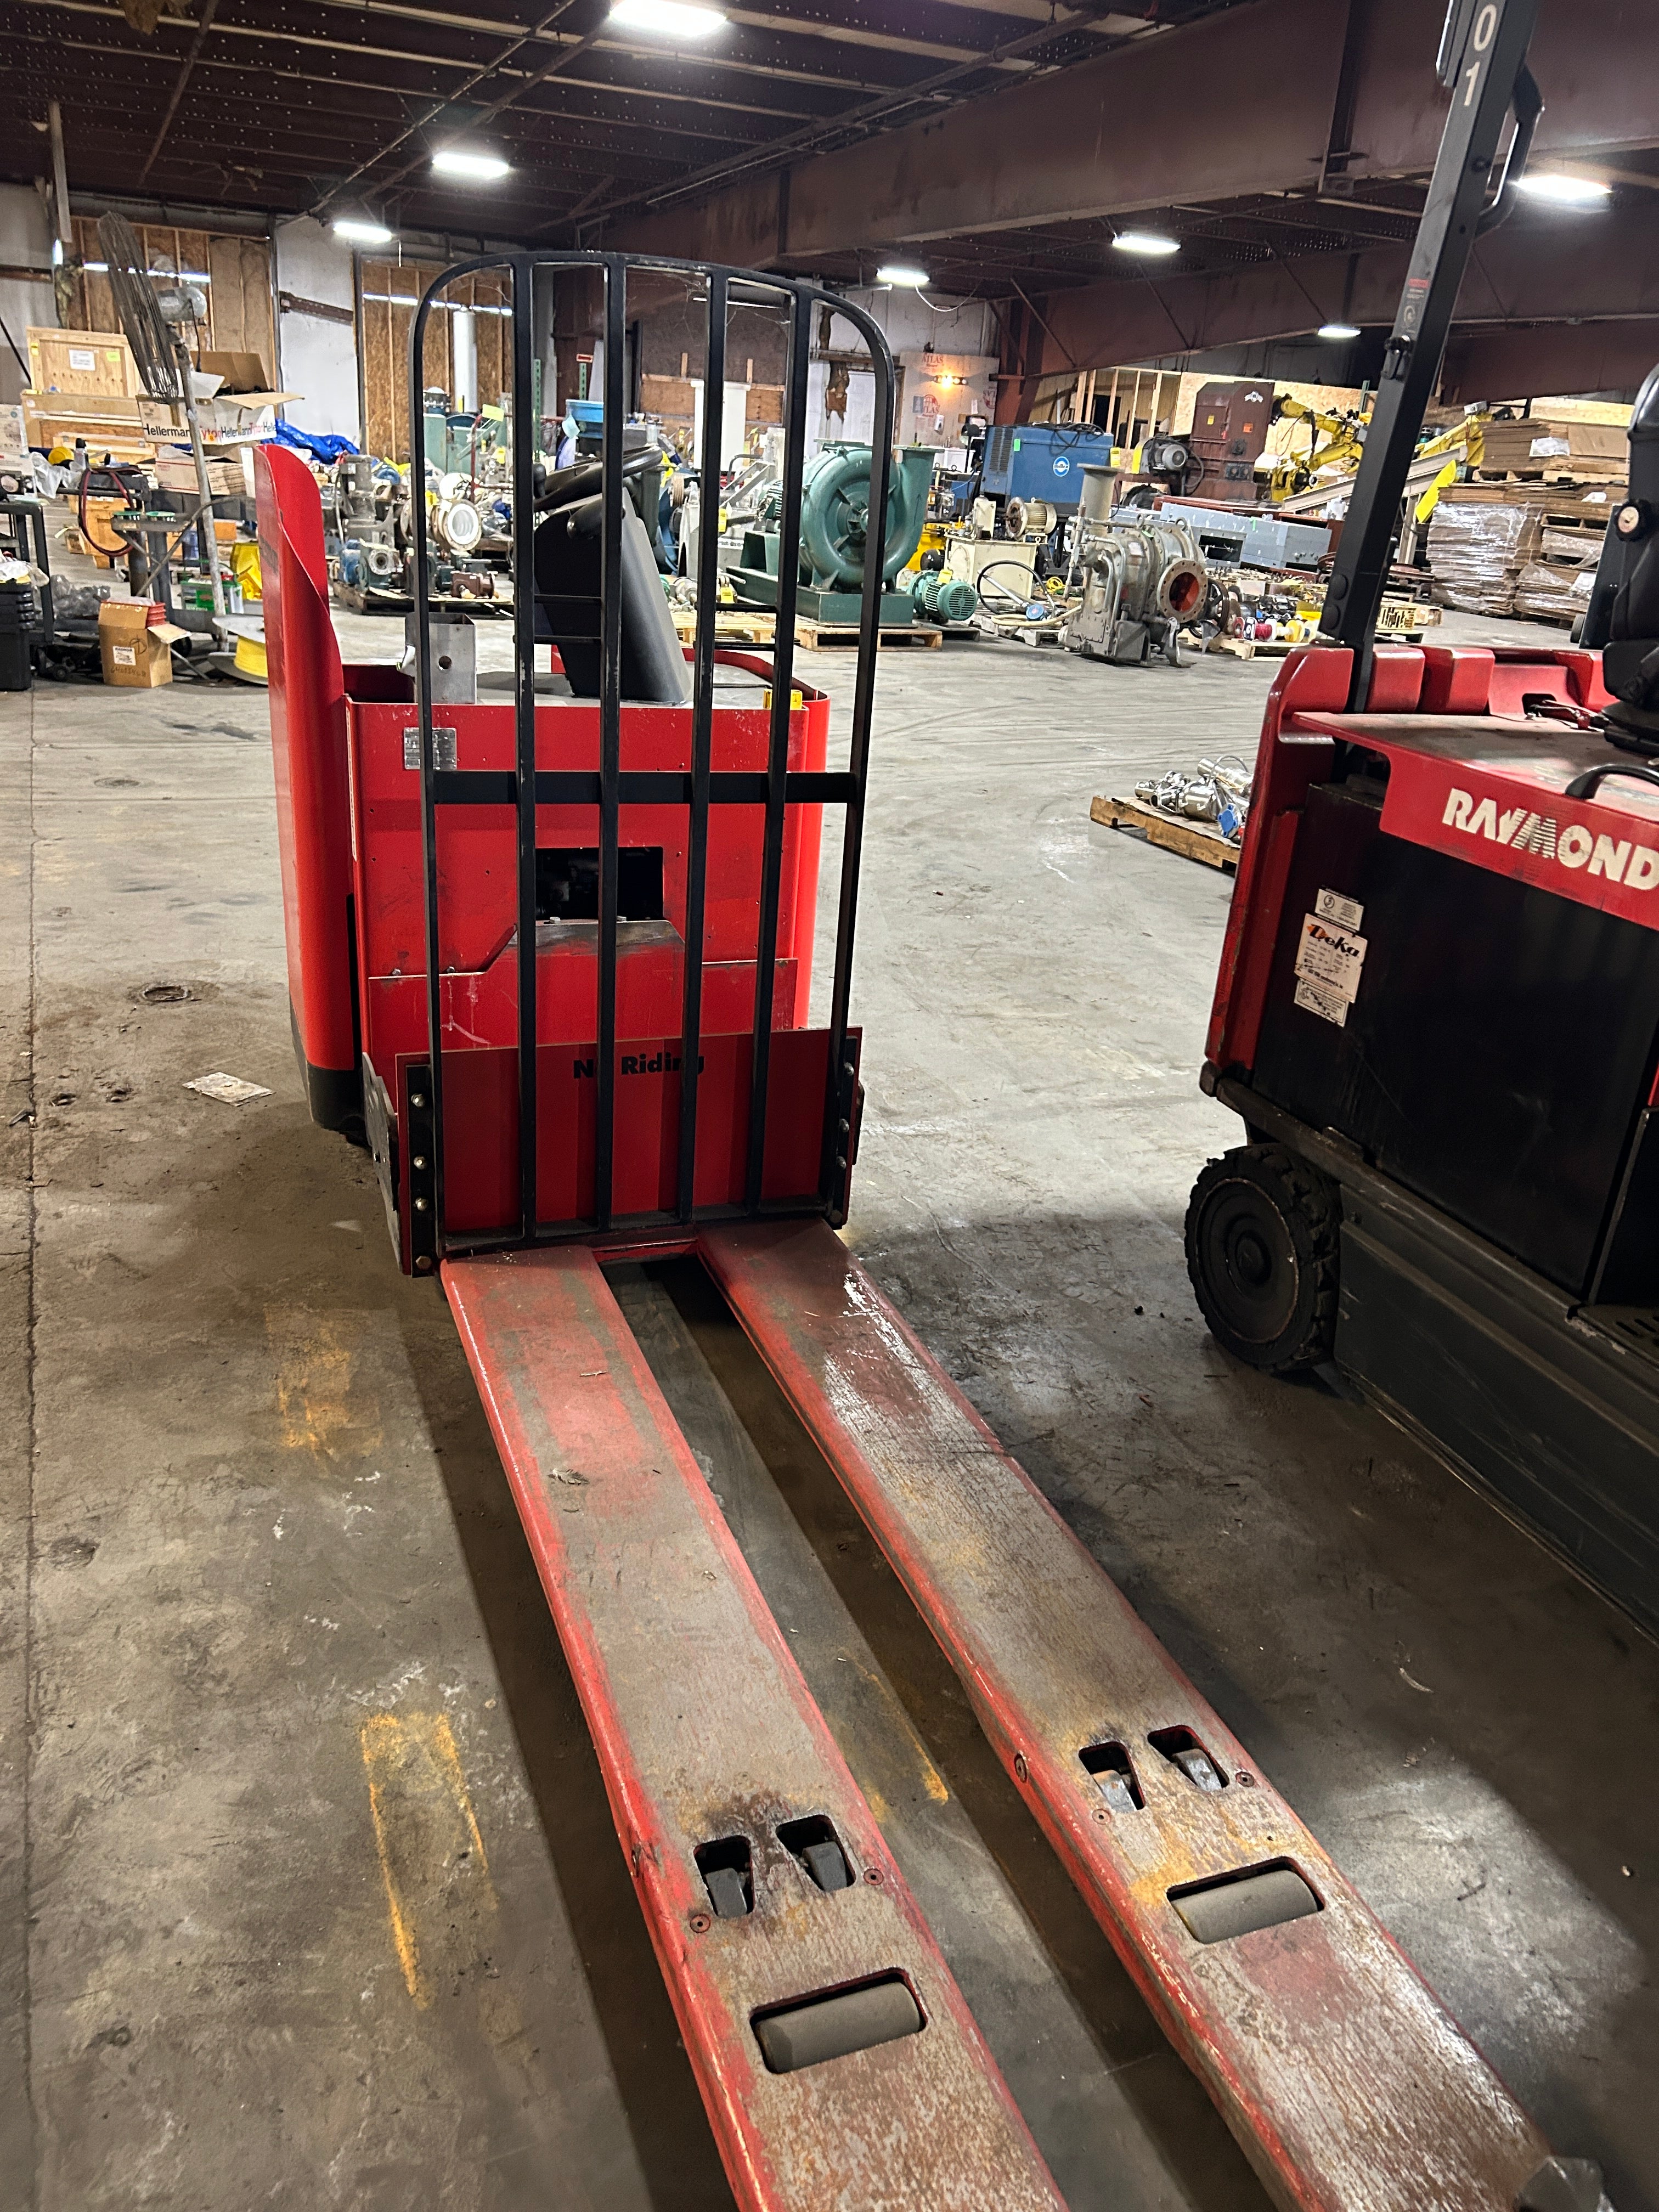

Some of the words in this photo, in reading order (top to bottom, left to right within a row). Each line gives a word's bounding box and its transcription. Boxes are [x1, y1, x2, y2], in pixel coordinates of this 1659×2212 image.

[1442, 787, 1659, 891] RAYMOND
[1310, 923, 1360, 957] Deka
[573, 1059, 599, 1079] N
